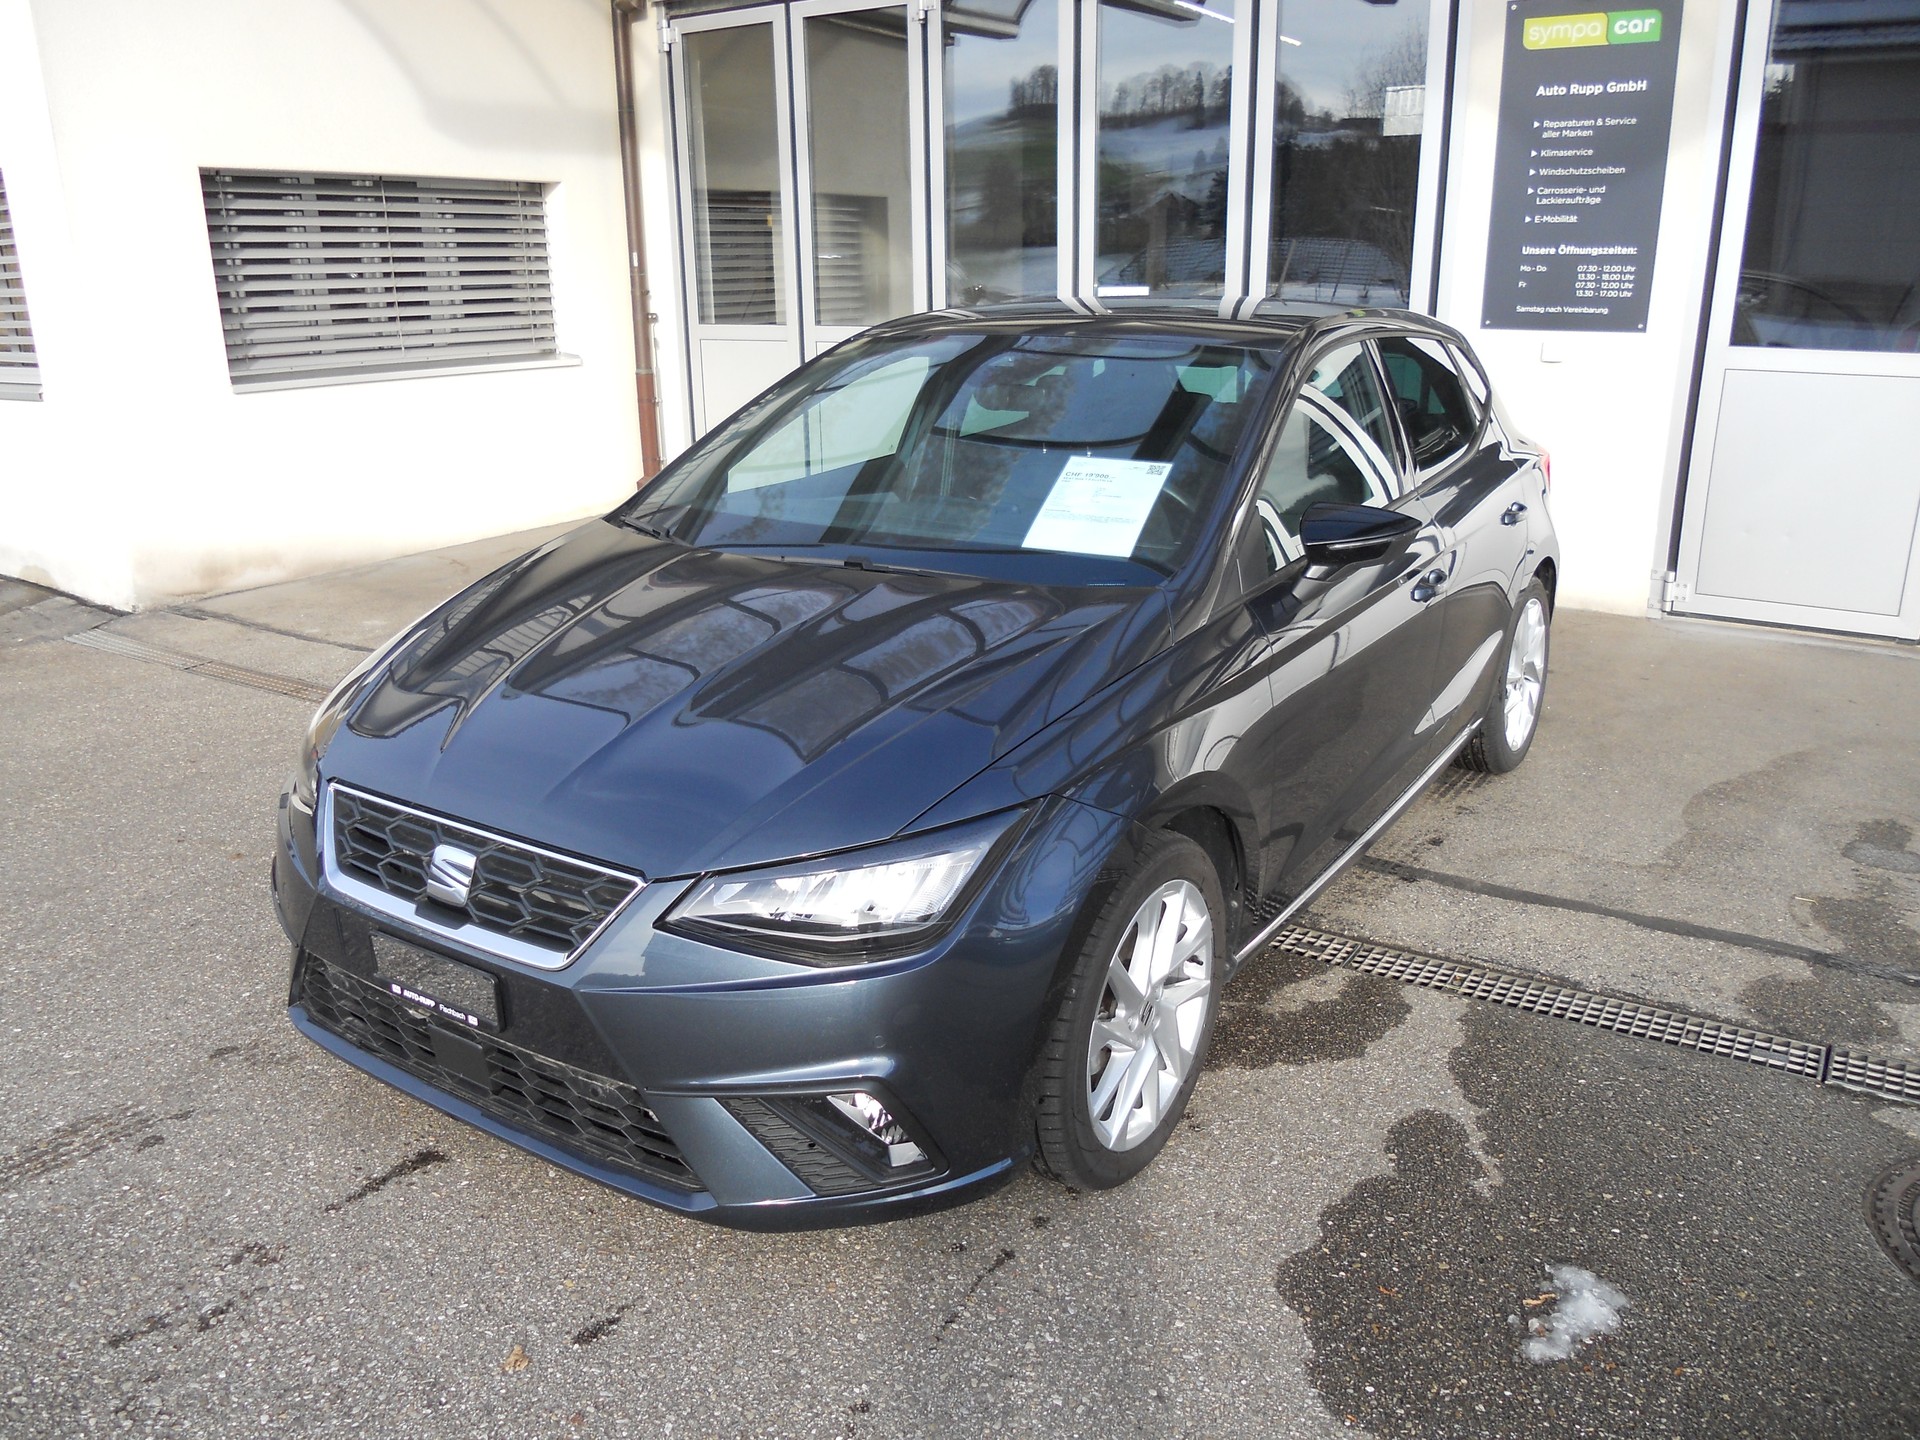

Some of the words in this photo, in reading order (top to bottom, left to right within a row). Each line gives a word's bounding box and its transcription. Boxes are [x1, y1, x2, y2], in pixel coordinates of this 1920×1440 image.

[1528, 21, 1601, 45] sympa
[1614, 17, 1656, 35] car
[1536, 85, 1566, 97] Auto
[1570, 83, 1604, 96] Rupp
[1606, 80, 1647, 93] GmbH
[1543, 119, 1595, 128] Reparaturen
[1596, 118, 1603, 126] &
[1605, 117, 1637, 126] Service
[1542, 130, 1560, 138] aller
[1562, 129, 1593, 138] Marken
[1540, 148, 1594, 157] Klimaservice
[1539, 166, 1626, 176] Windschutzscheiben
[1537, 187, 1587, 195] Carrosserie-
[1589, 186, 1606, 194] und
[1536, 196, 1602, 206] Lackieraufträge
[1534, 215, 1578, 223] E-Mobilität
[1522, 246, 1556, 255] Unsere
[1558, 244, 1637, 256] Öffnungszeiten:
[1599, 290, 1618, 298] 17.00
[1516, 305, 1545, 314] Samstag
[1563, 306, 1609, 315] Vereinbarung
